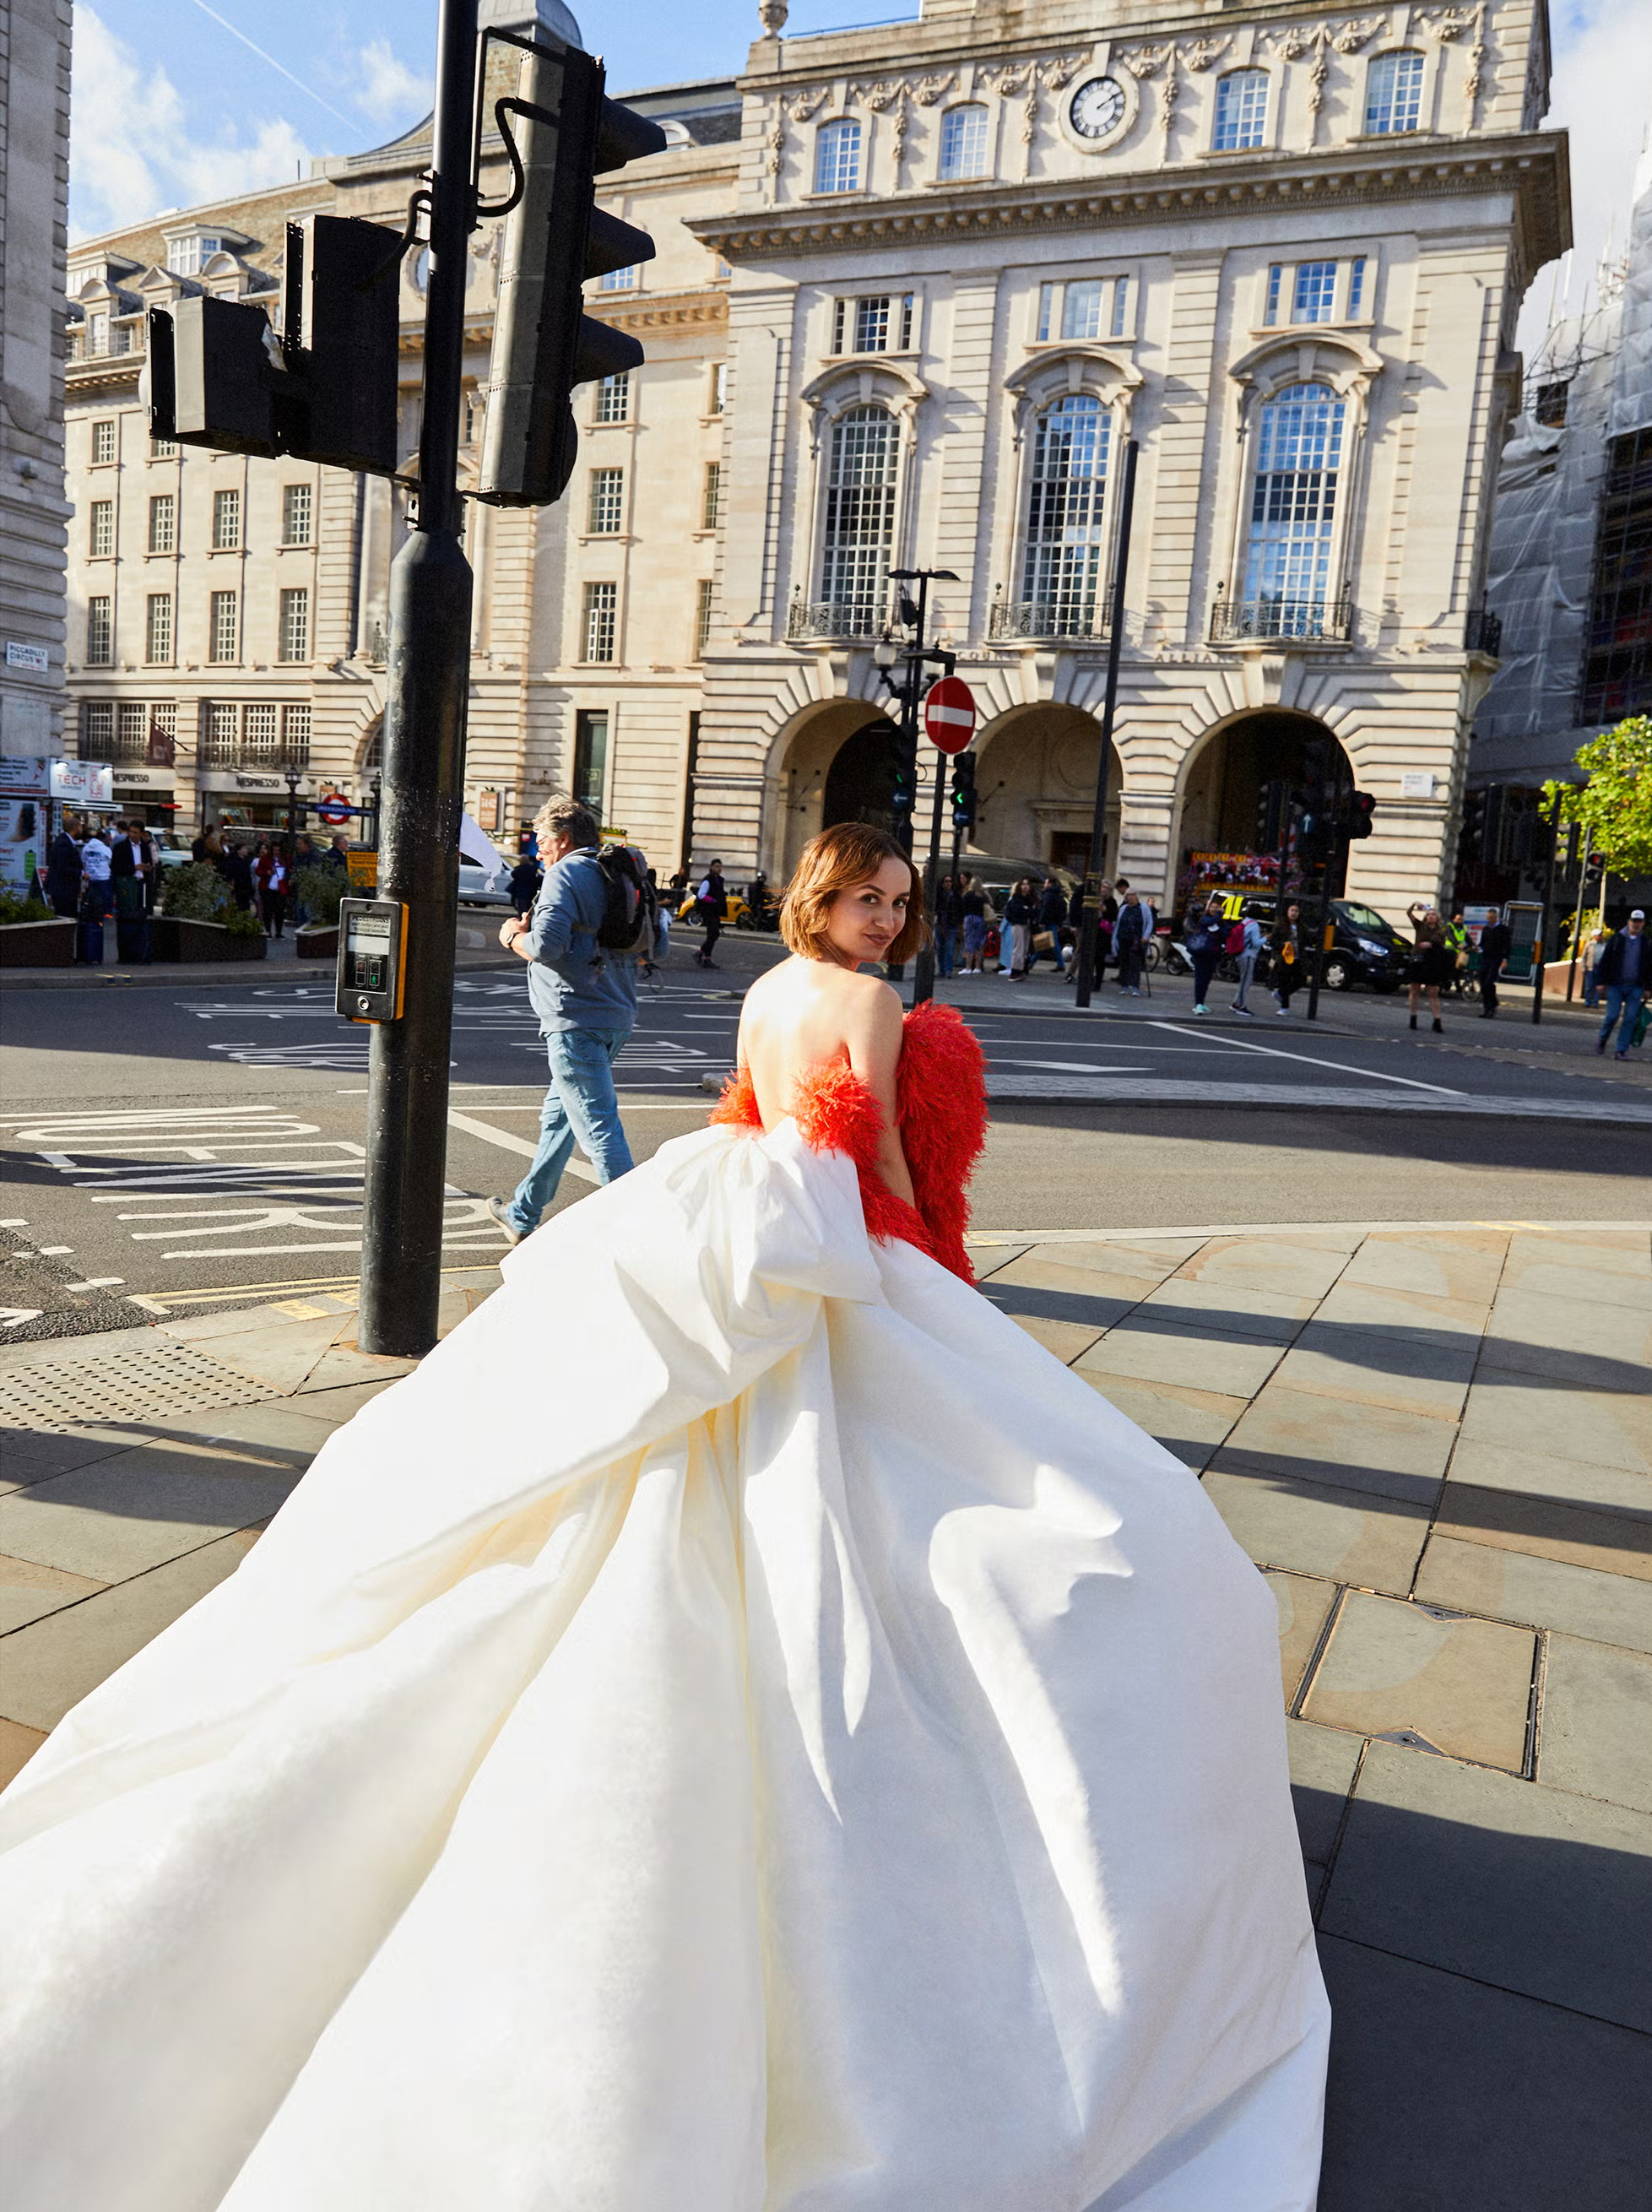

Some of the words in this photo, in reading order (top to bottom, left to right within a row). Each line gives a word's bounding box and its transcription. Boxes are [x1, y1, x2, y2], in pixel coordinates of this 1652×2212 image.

[10, 645, 46, 657] PICCADILLY
[10, 653, 34, 662] CIRCUS
[57, 773, 86, 786] TECH
[114, 773, 149, 783] NESPRESSO
[236, 775, 280, 789] NESPRESSO
[352, 915, 389, 924] PEDESTRIANS
[36, 1141, 513, 1259] ENTRY
